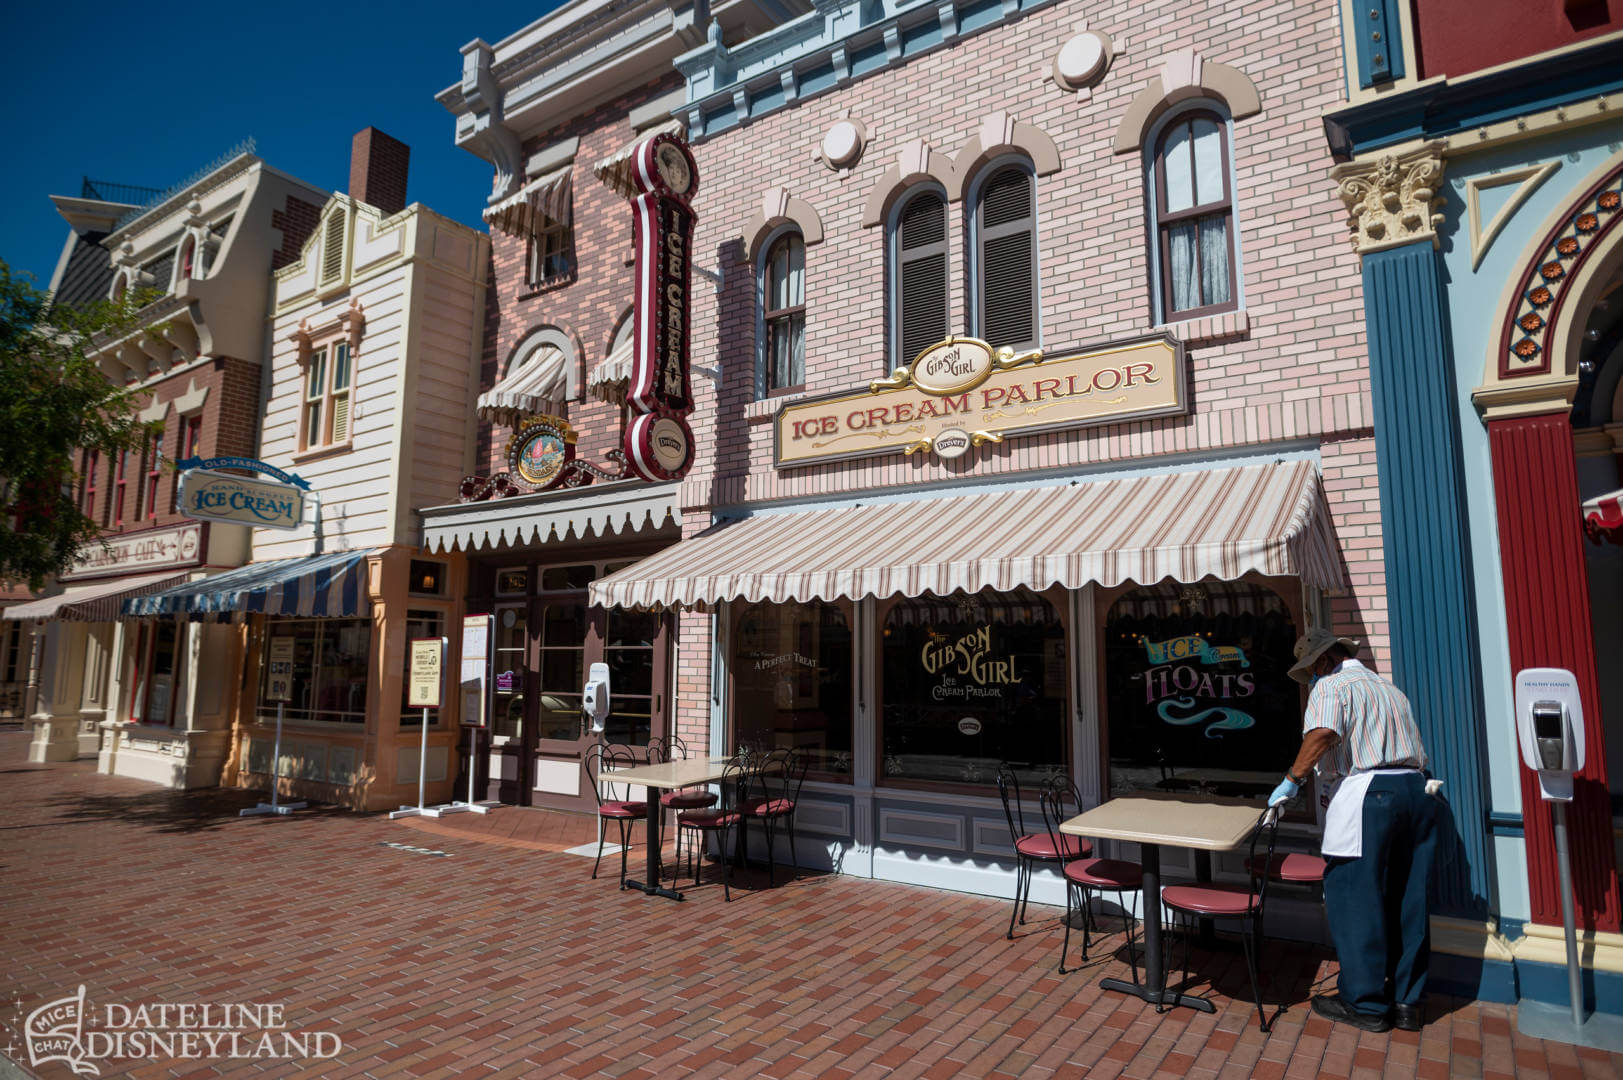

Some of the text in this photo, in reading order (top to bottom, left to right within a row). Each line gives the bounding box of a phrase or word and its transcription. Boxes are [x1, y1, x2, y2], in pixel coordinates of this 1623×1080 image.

[664, 210, 683, 398] ICE CREAM
[926, 348, 961, 376] GIBSON
[950, 360, 976, 377] GIRL
[792, 363, 1160, 440] ICE CREAM PARLOR
[205, 460, 288, 481] OLD-FASHIONED
[193, 490, 294, 520] ICE CREAM
[793, 652, 817, 667] TREAT
[922, 624, 991, 674] GIBSON
[1161, 638, 1202, 659] ICE
[942, 673, 957, 687] ICE
[971, 651, 1023, 685] GIRL
[932, 685, 1002, 700] CREAM PARLOR
[1144, 665, 1255, 704] FLOATS
